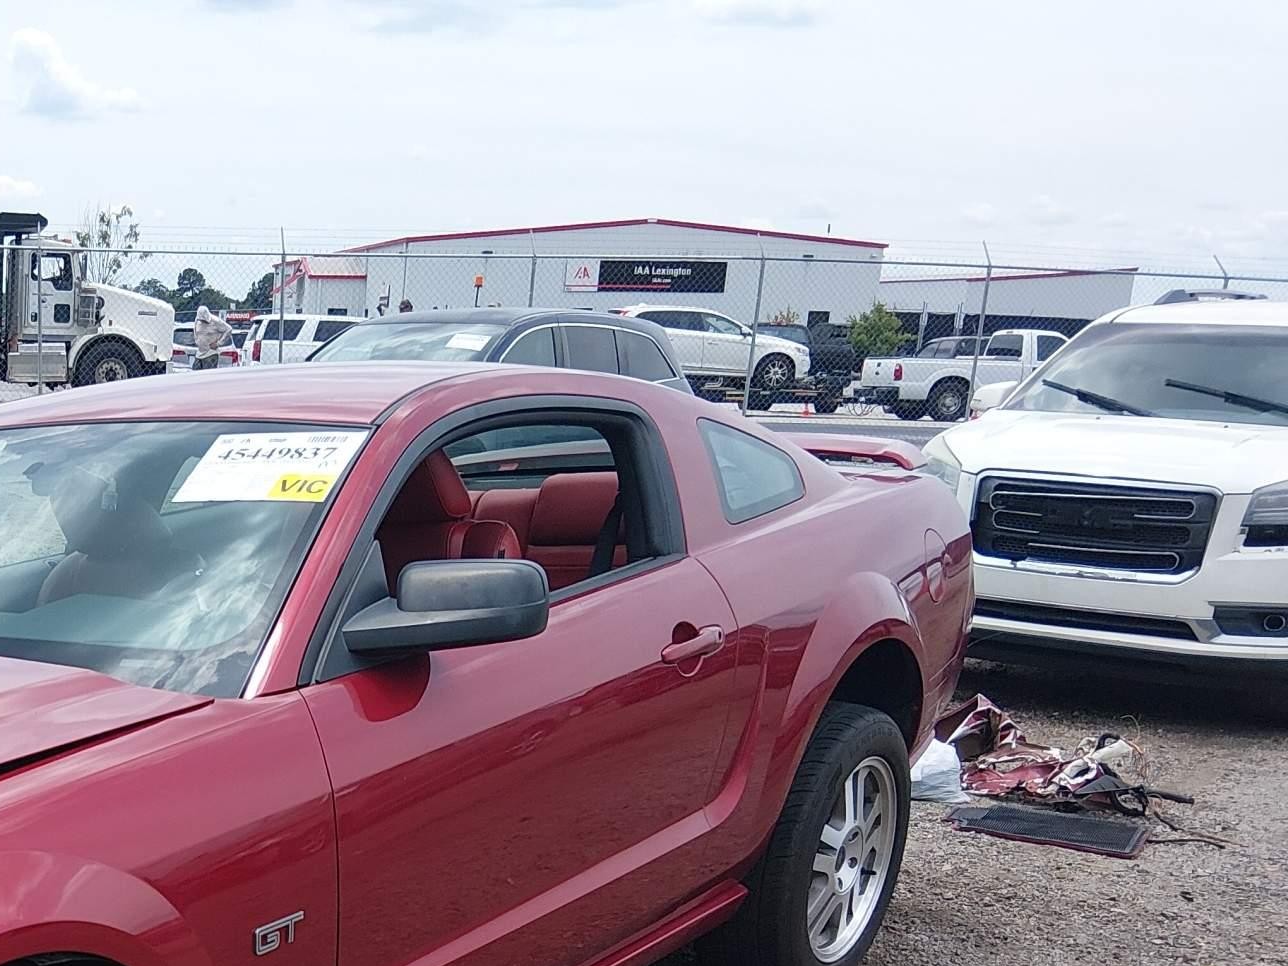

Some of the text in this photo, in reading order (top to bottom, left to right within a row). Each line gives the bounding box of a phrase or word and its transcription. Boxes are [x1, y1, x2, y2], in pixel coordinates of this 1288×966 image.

[633, 265, 692, 277] IAA Lexington
[218, 447, 338, 461] 45449837
[280, 479, 328, 494] VIC
[255, 910, 304, 955] GT
